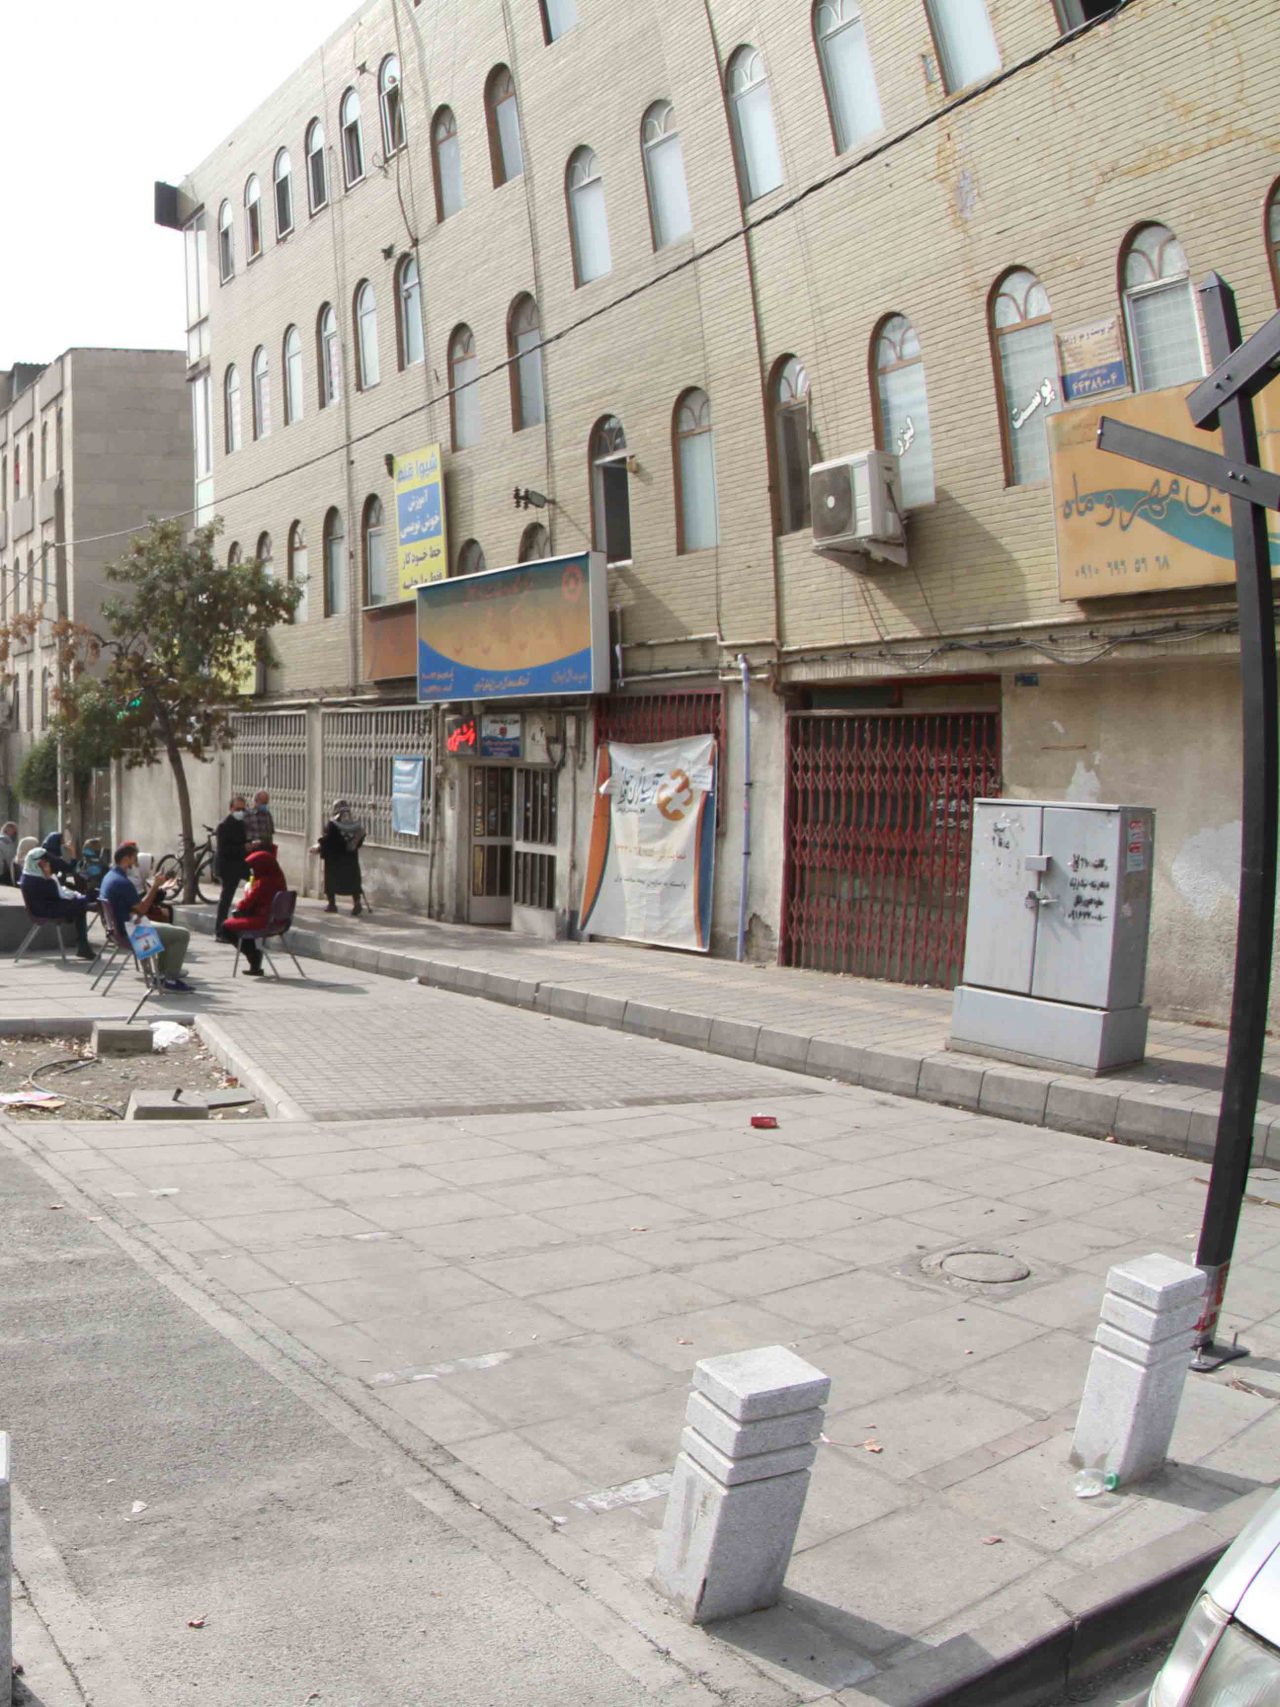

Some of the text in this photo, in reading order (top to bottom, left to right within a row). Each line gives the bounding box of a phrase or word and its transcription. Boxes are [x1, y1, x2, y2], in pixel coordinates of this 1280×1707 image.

[1012, 377, 1056, 430] پوست
[897, 415, 915, 457] لیزر
[397, 452, 438, 482] شیوا قلم
[407, 489, 429, 513] آموزش
[1062, 472, 1095, 520] ماه
[1096, 494, 1115, 527] و
[1119, 478, 1181, 532] مهر
